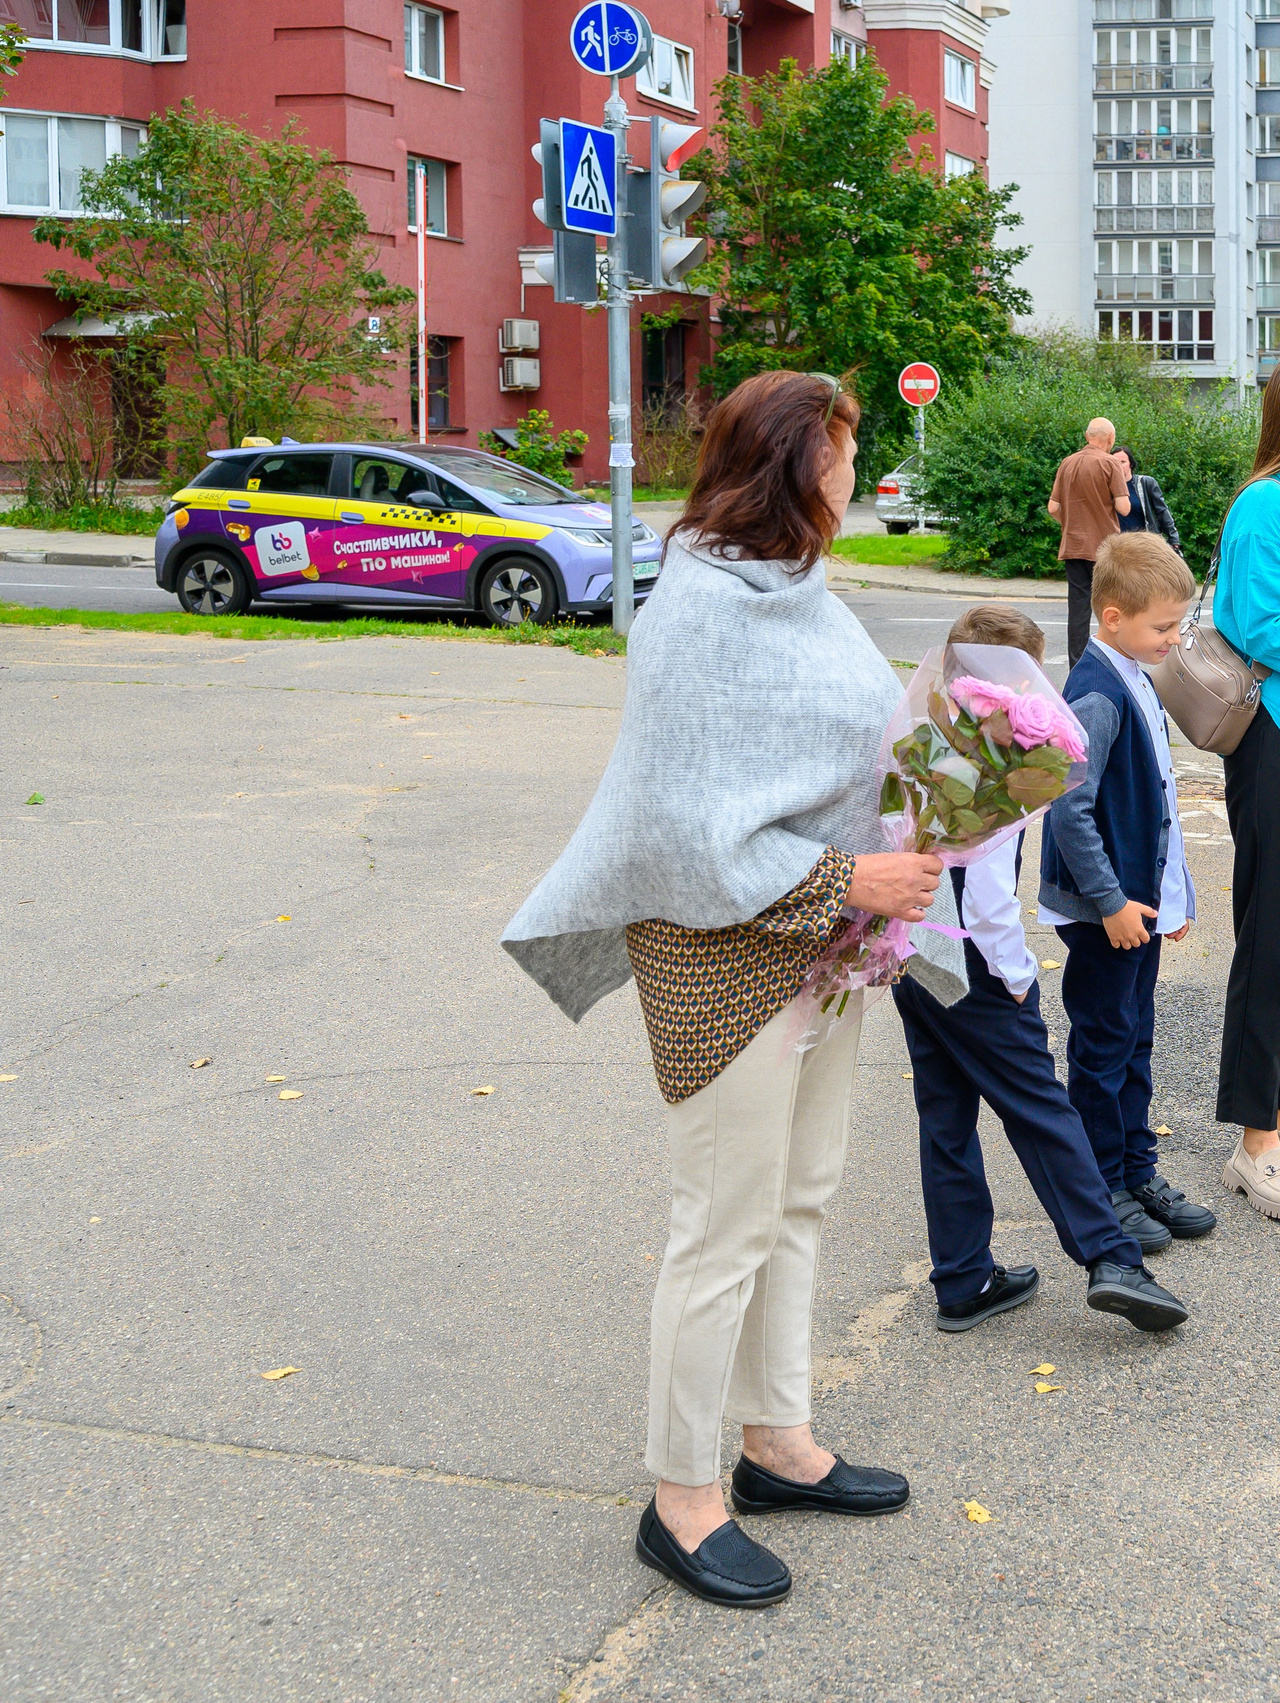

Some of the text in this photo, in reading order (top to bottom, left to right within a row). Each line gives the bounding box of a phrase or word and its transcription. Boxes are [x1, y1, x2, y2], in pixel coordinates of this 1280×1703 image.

[197, 492, 220, 501] E485
[333, 530, 442, 555] Счастливчики,
[268, 551, 303, 566] belbet
[391, 551, 450, 569] машинам!
